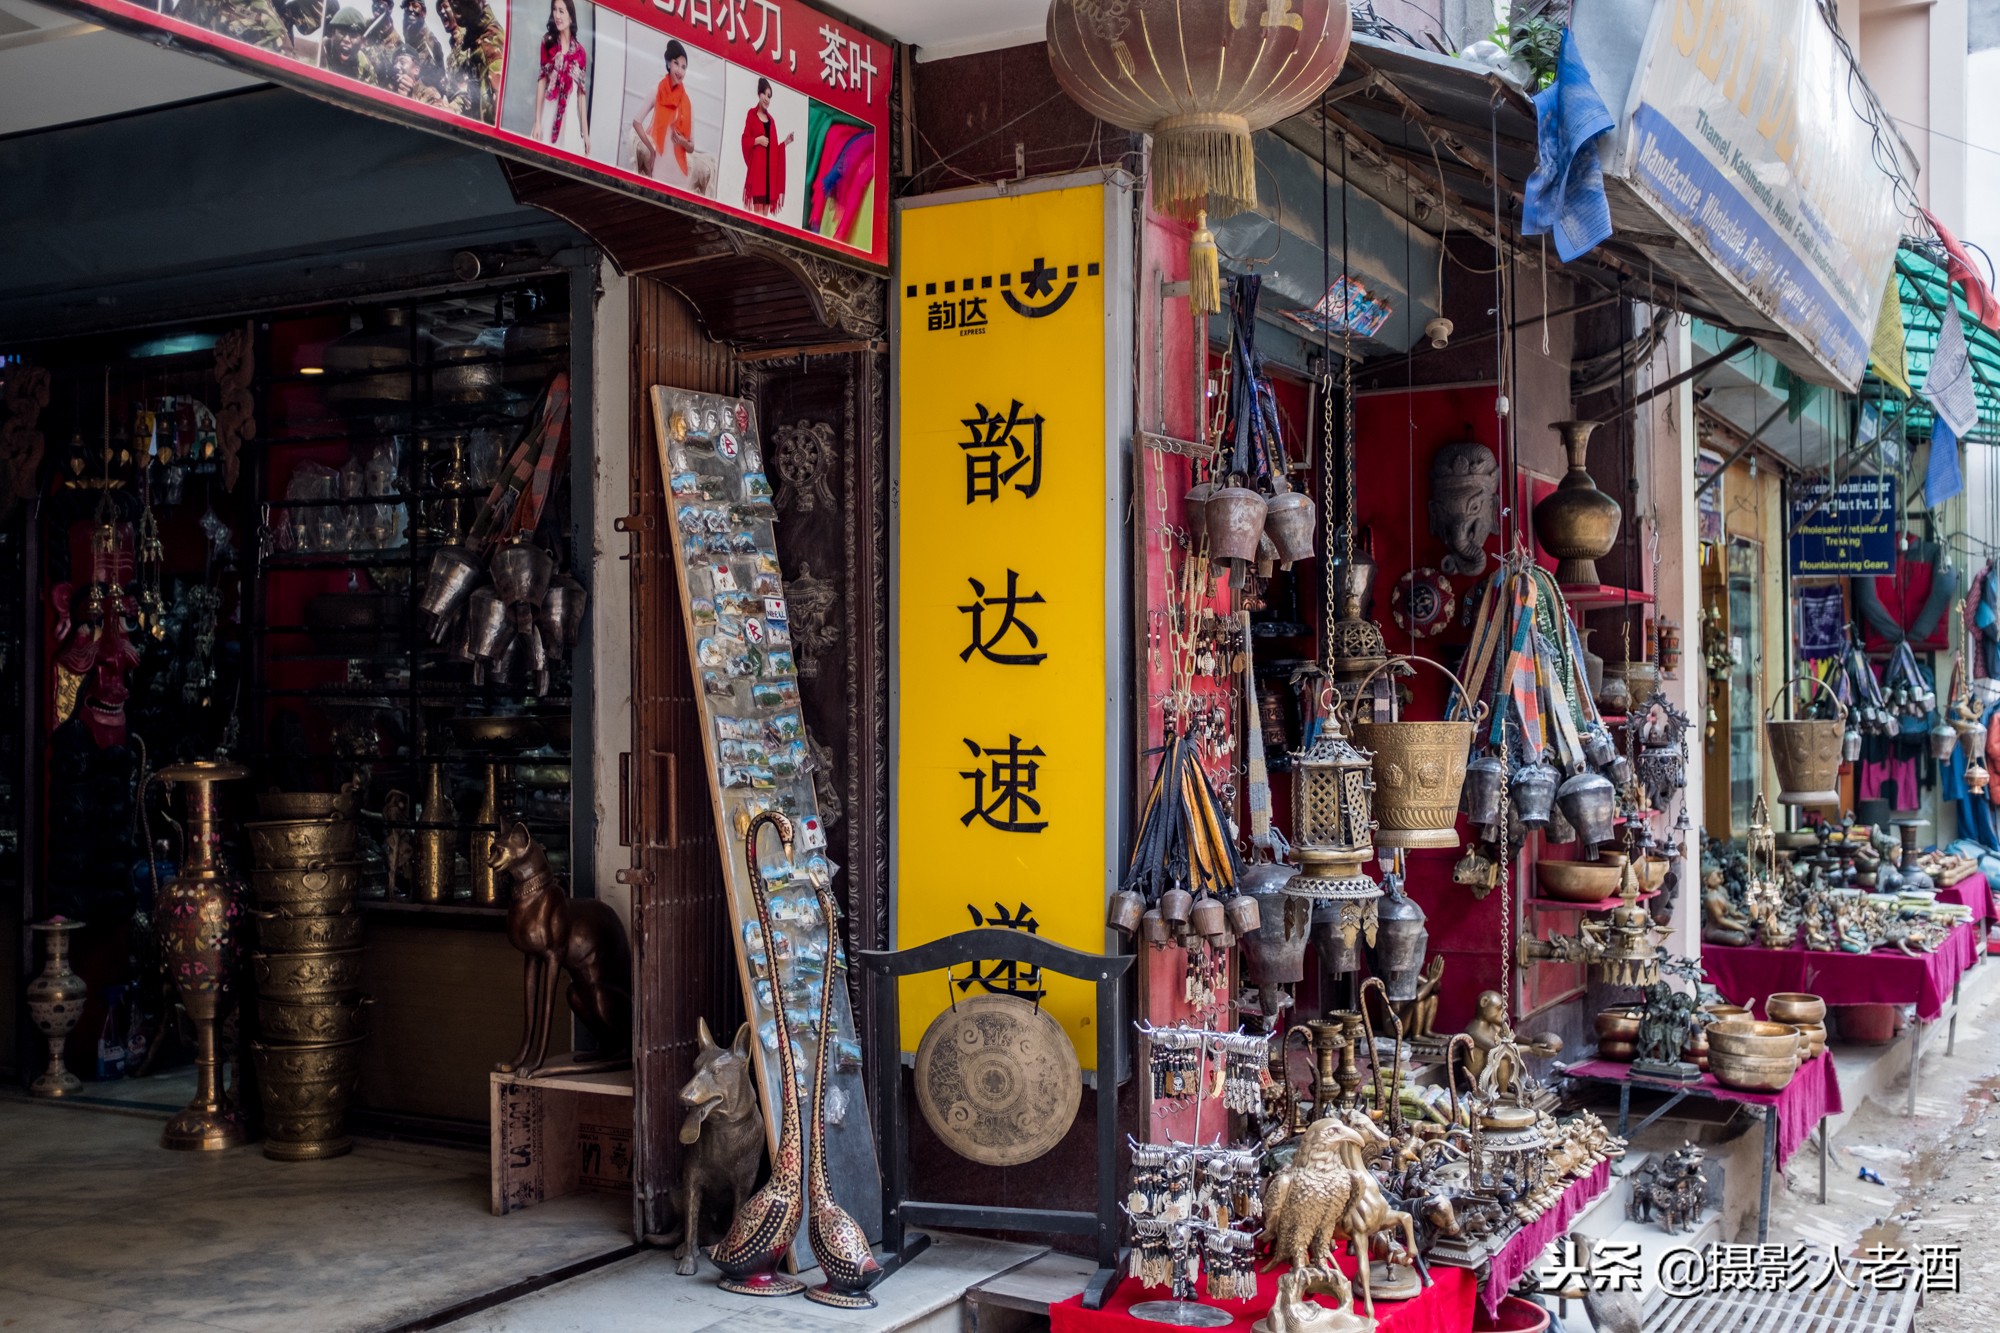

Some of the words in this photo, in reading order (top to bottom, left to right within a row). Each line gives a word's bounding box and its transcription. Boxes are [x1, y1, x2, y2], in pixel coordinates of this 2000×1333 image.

[1695, 107, 1731, 164] Thamel,
[1731, 148, 1774, 214] Kathmandu,
[1638, 131, 1703, 214] Manufacture,
[1698, 193, 1747, 260] Wholeshale,
[928, 297, 988, 332] 韵达
[959, 327, 986, 337] EXPRESS
[1875, 499, 1892, 510] Ld.
[1849, 524, 1878, 534] retailer
[1879, 524, 1889, 533] of
[1839, 548, 1847, 558] &
[1863, 560, 1889, 570] Gears
